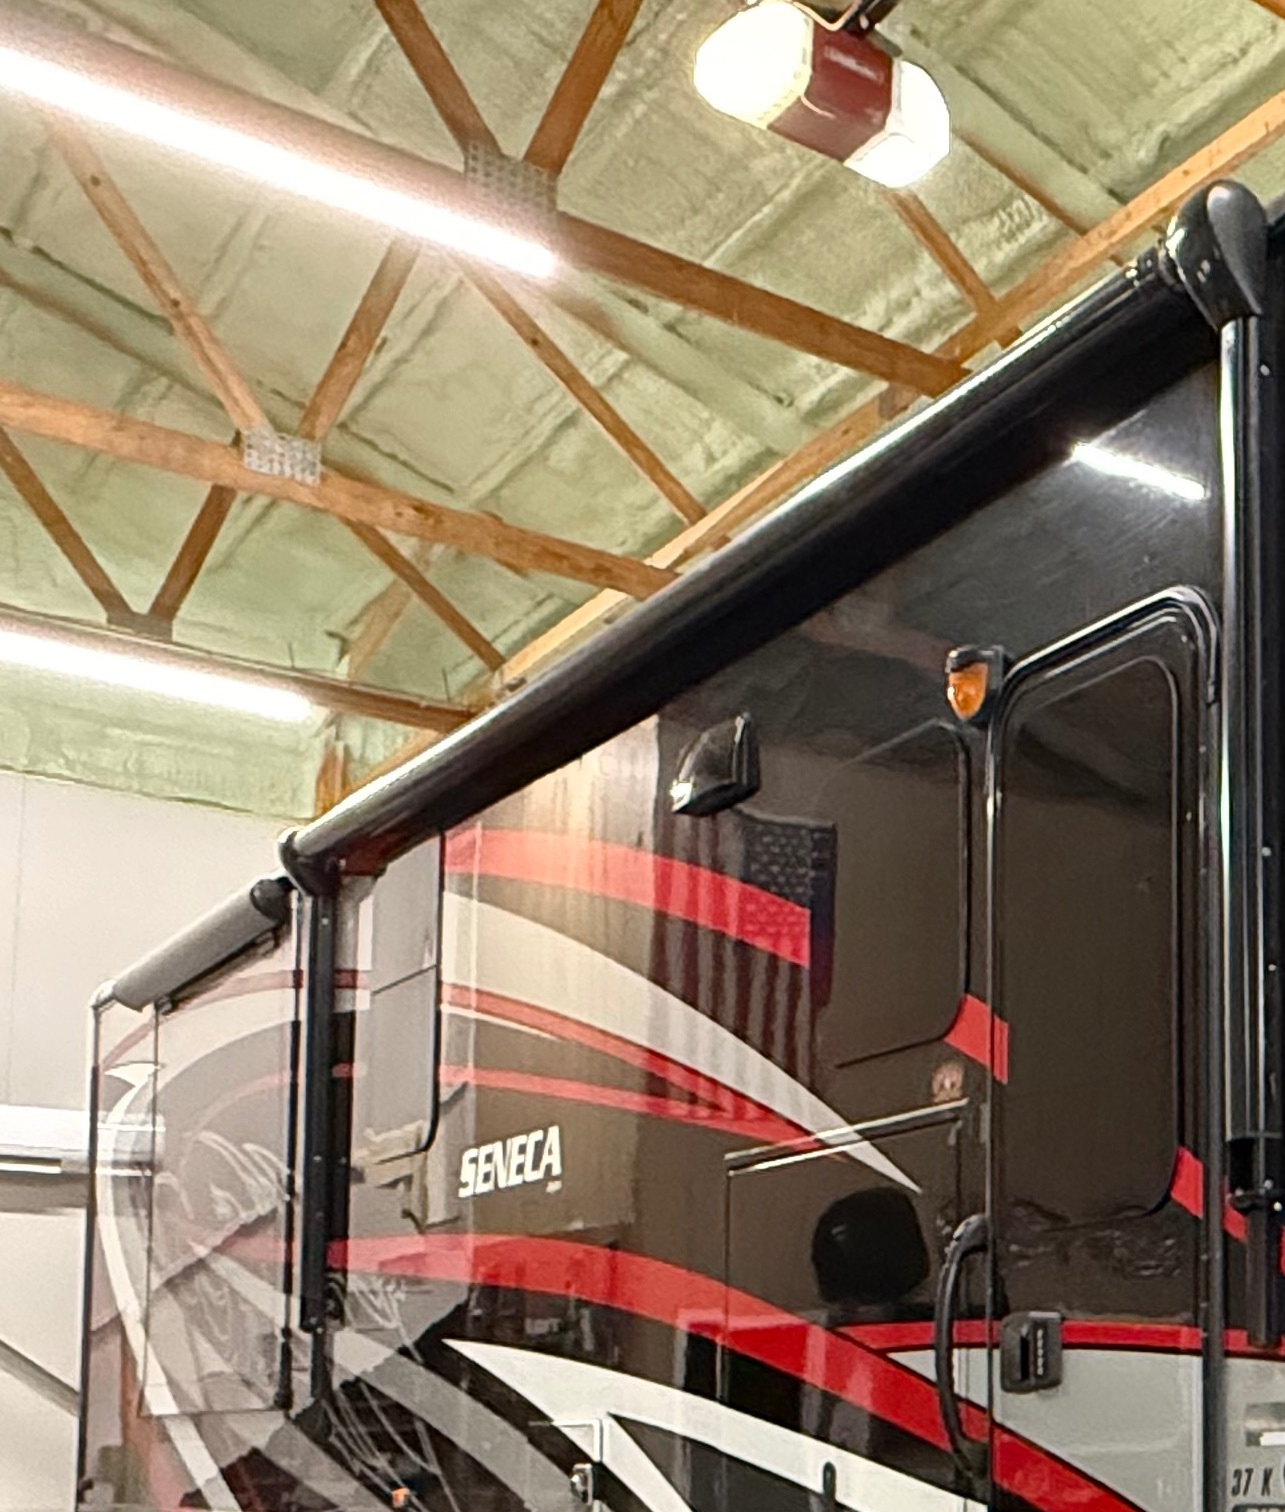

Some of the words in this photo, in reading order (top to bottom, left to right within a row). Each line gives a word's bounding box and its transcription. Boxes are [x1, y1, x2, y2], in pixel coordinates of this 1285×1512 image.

[457, 1124, 563, 1199] SENECA
[1230, 1466, 1254, 1497] 37
[1260, 1466, 1275, 1497] K
